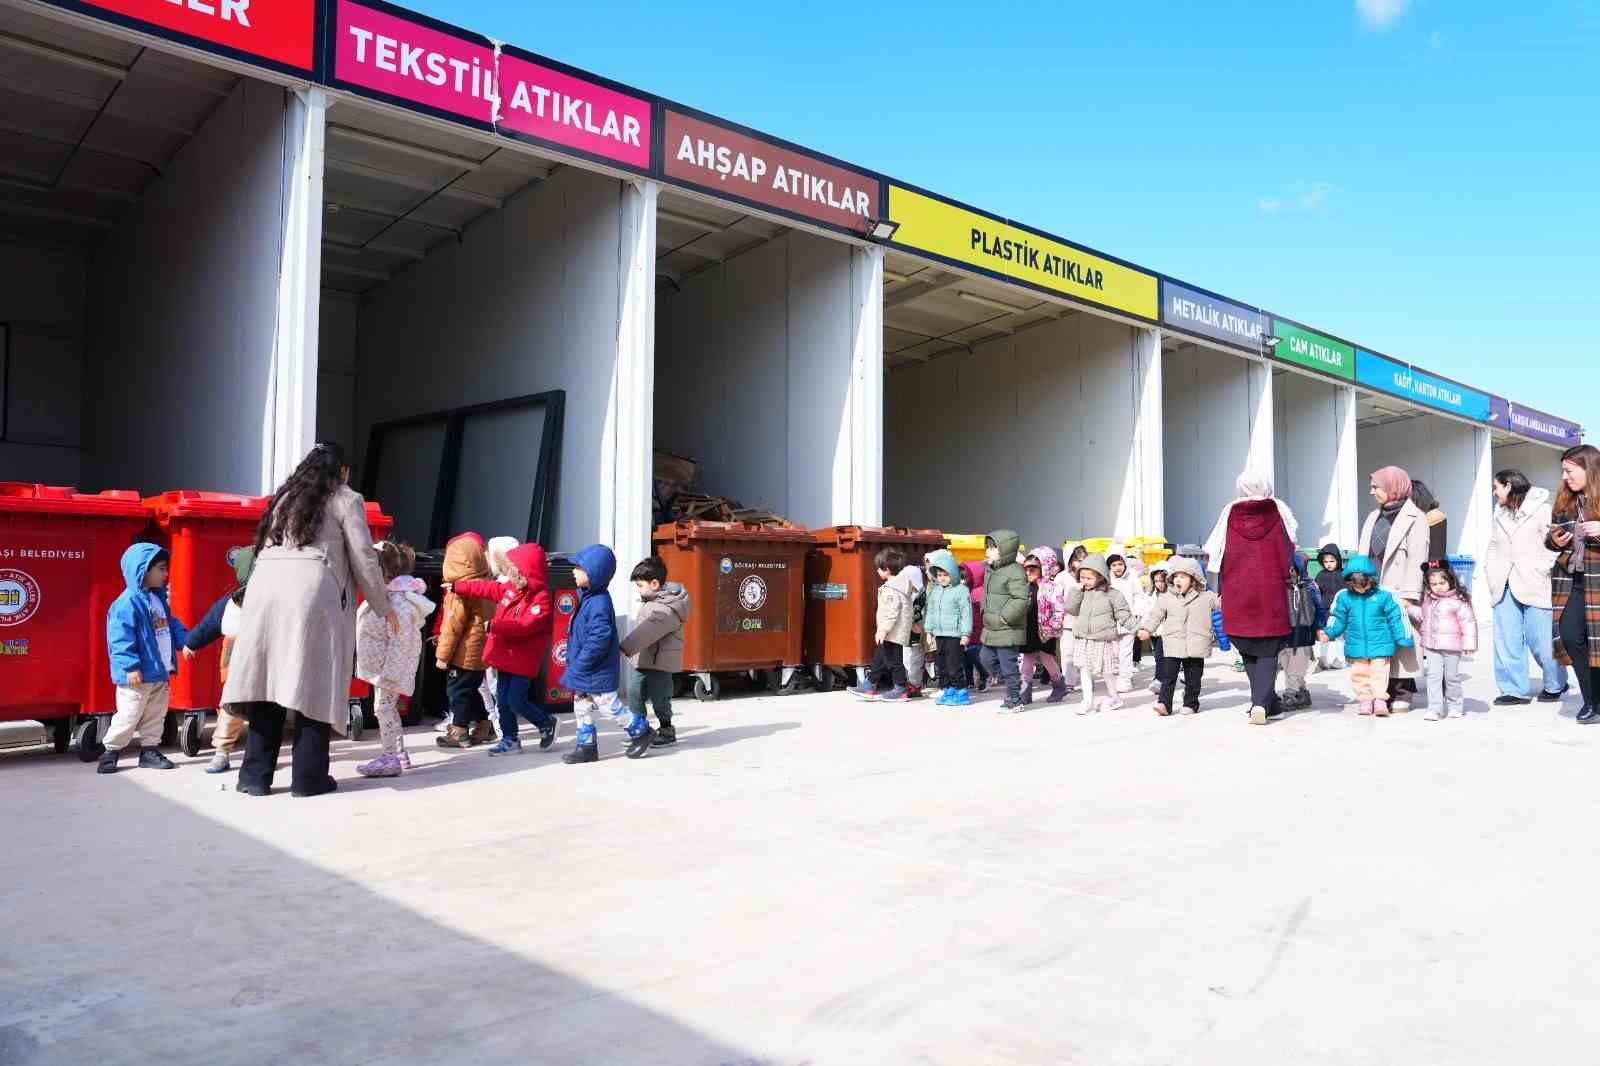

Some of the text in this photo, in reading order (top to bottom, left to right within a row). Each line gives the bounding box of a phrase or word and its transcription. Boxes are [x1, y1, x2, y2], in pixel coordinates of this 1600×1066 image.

[350, 26, 641, 148] TEKSTİL ATIKLAR
[677, 134, 870, 216] AHŞAP ATIKLAR
[971, 227, 1104, 291] PLASTİK ATIKLAR
[1172, 296, 1263, 340] METALİK ATIKLAR
[1290, 336, 1343, 366] CAM ATIKLAR
